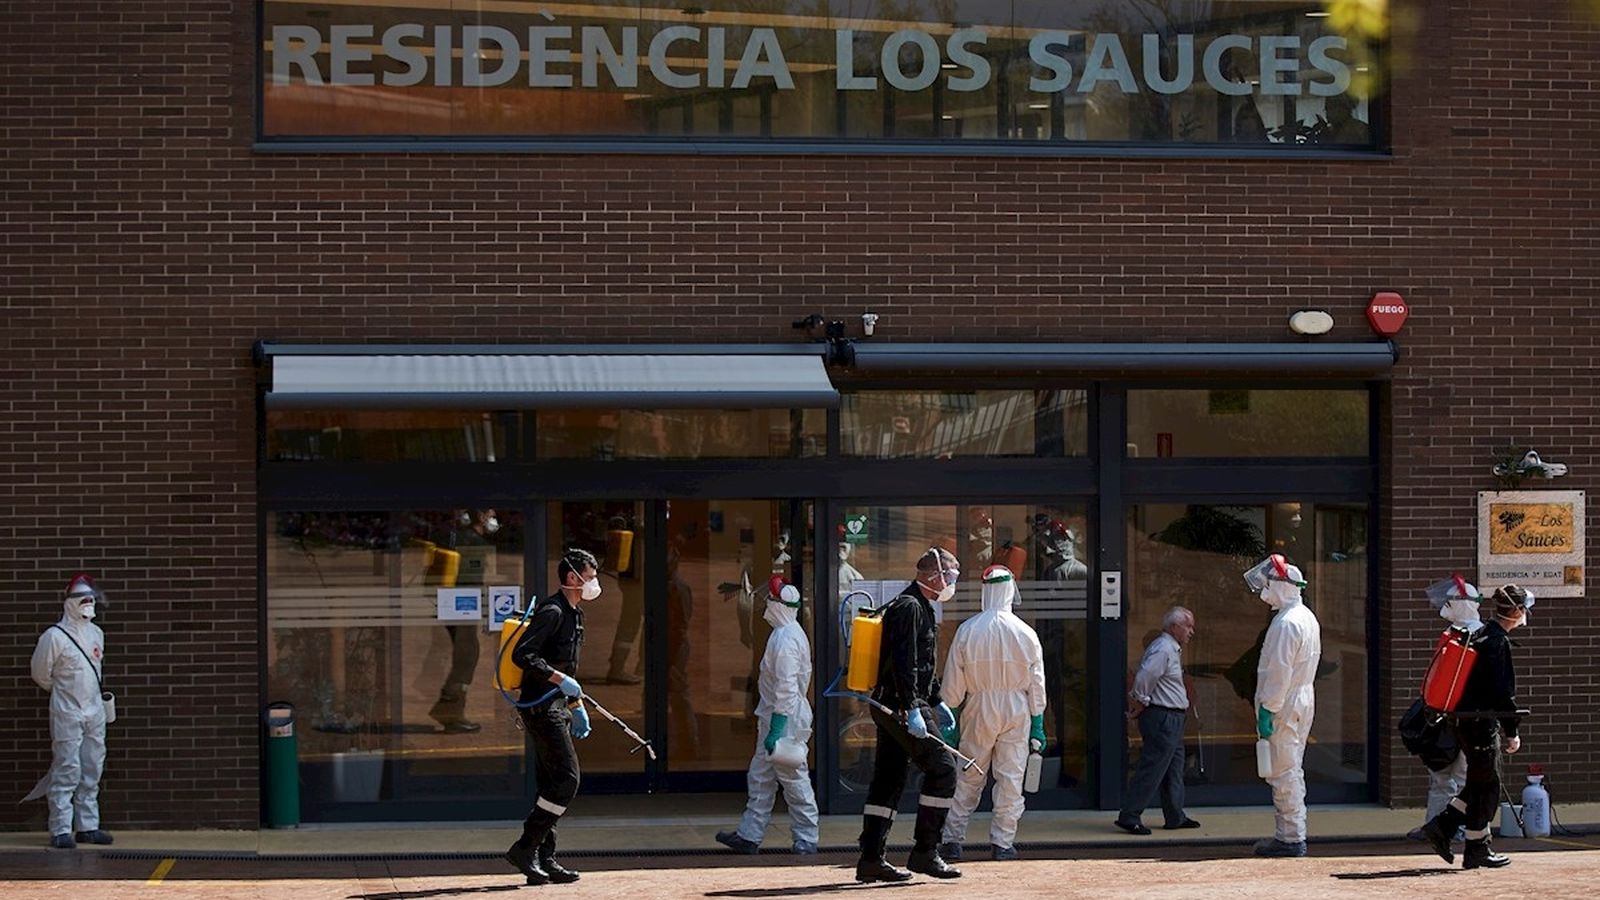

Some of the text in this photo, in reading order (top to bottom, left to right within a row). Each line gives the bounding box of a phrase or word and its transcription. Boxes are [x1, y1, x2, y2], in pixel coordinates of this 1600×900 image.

[271, 8, 1352, 96] RESIDÈNCIA LOS SAUCES
[1372, 305, 1405, 313] FUEGO
[1539, 514, 1563, 527] Los
[1514, 532, 1566, 549] Sauces
